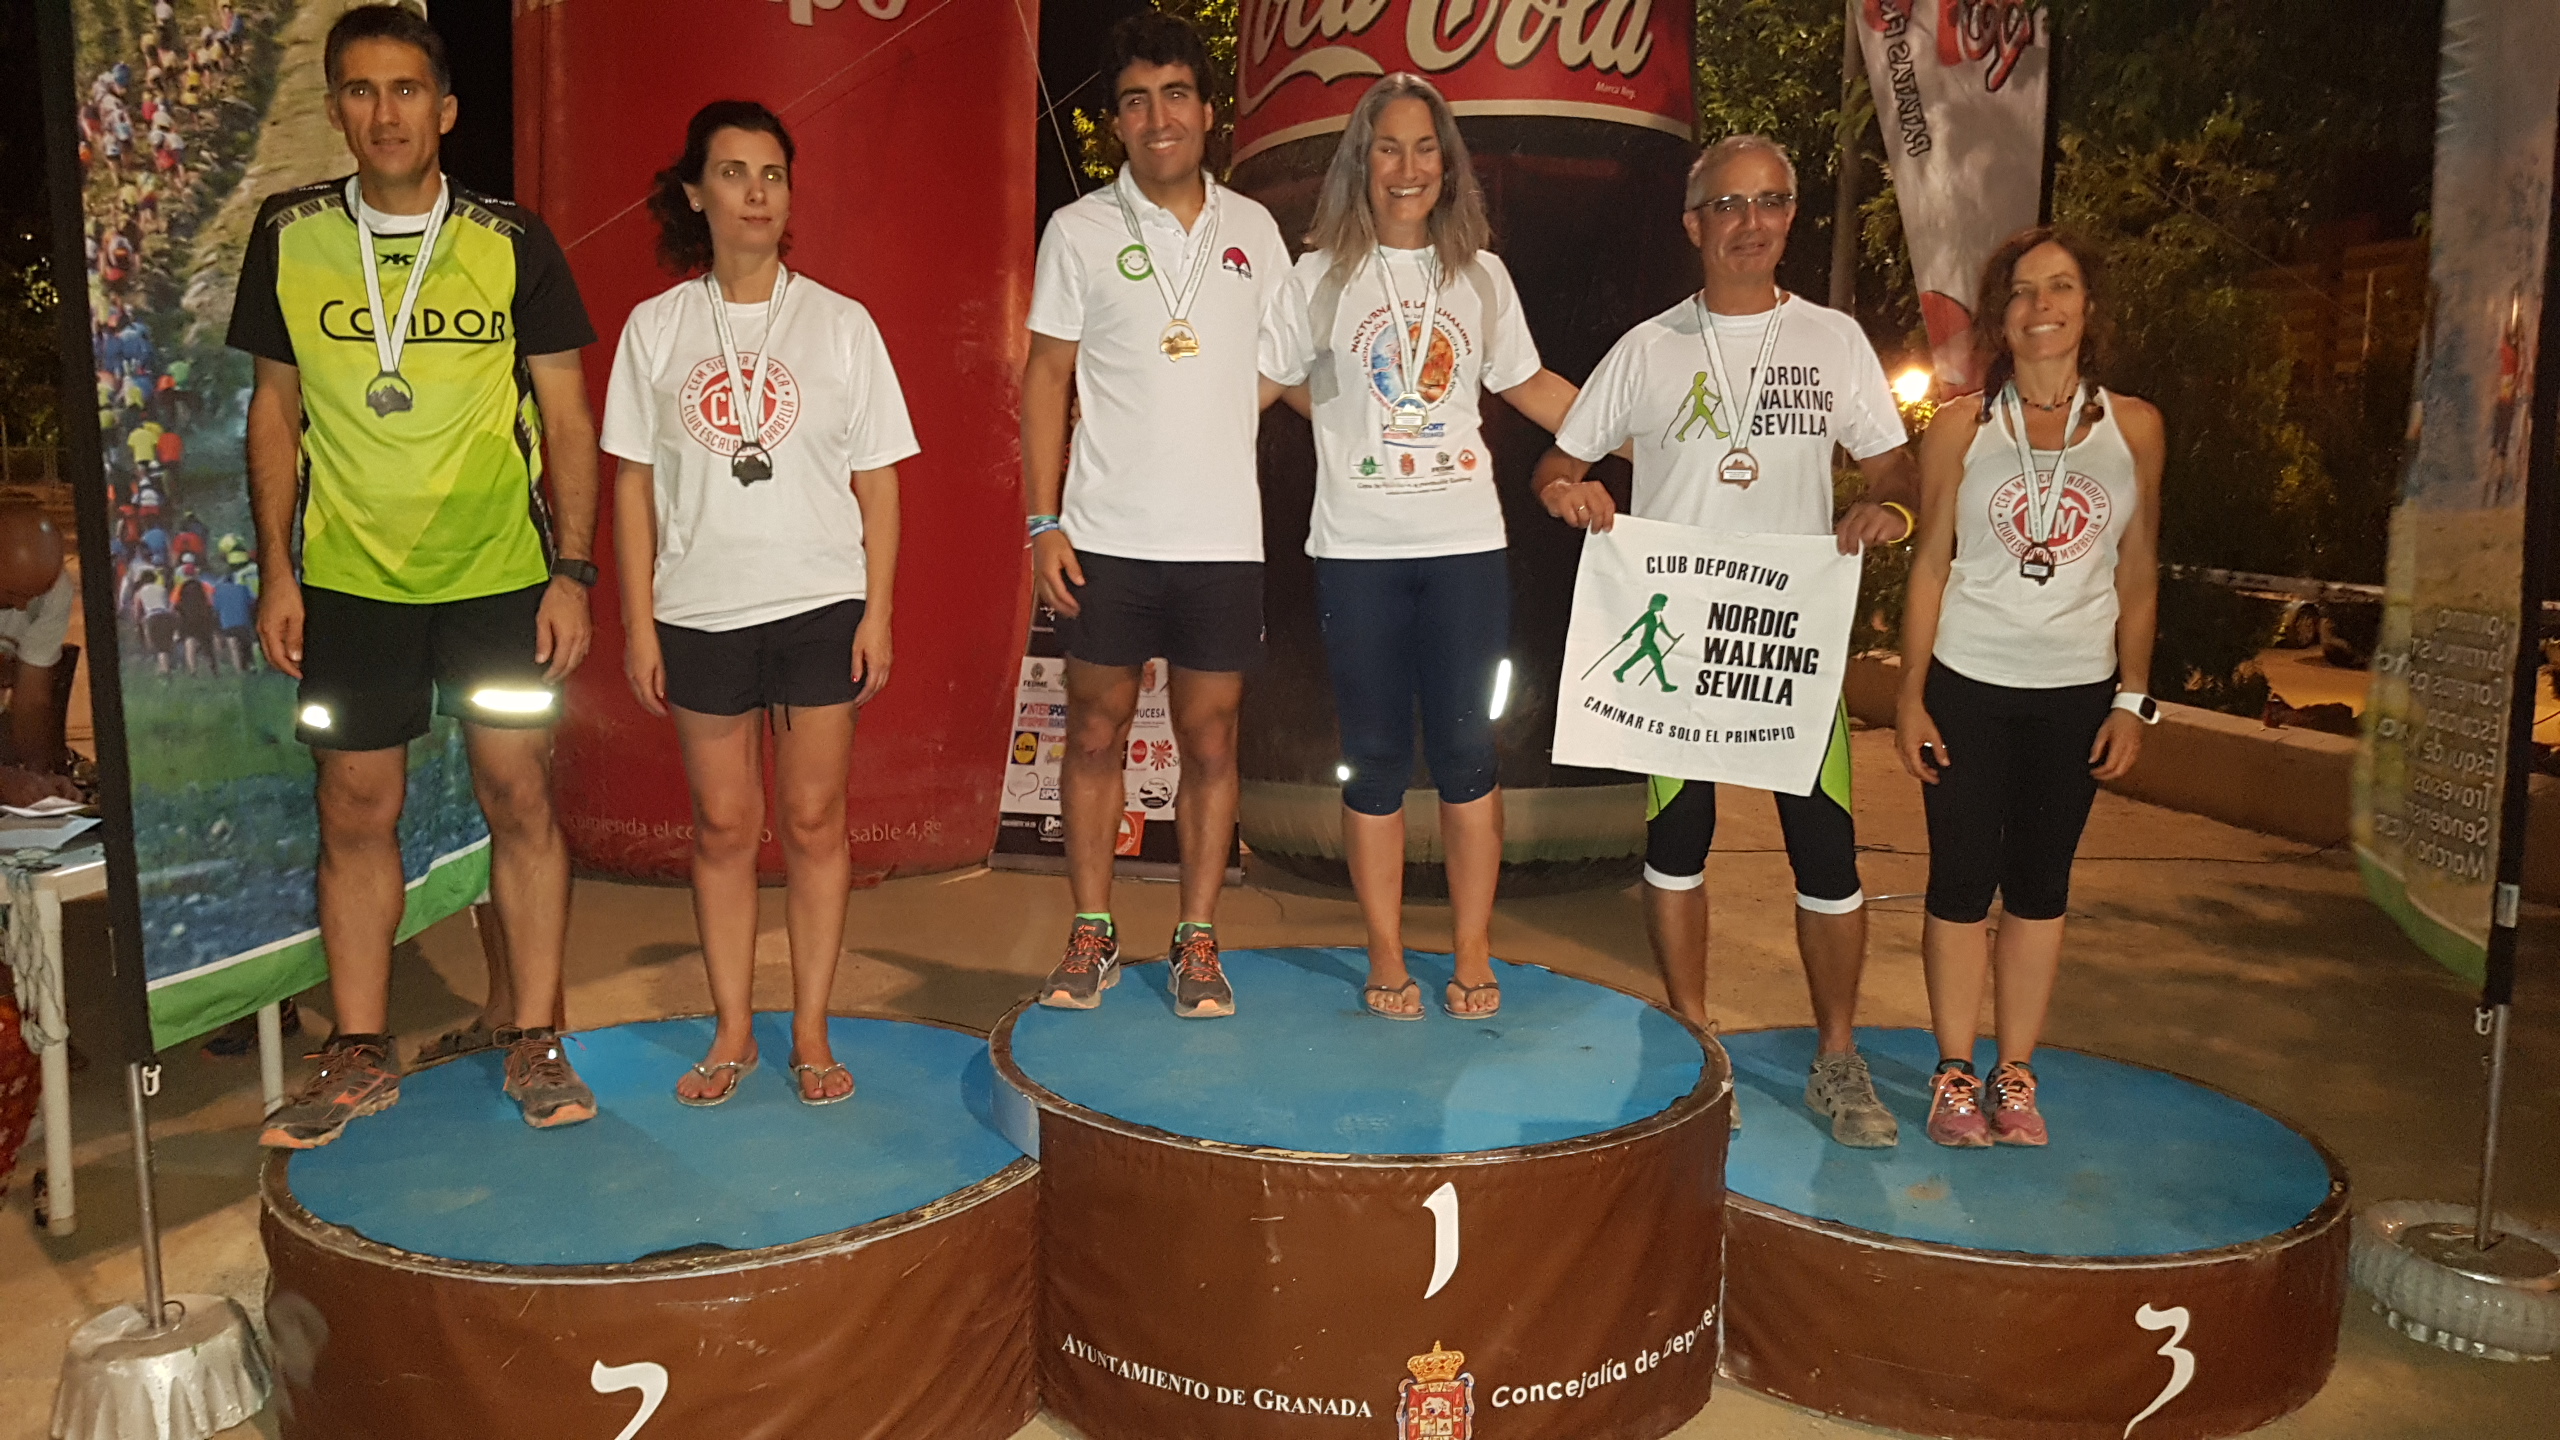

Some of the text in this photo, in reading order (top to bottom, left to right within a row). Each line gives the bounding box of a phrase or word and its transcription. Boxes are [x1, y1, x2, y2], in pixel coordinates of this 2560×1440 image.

[688, 369, 708, 391] CEM
[684, 400, 795, 453] CLUB ESCALA MARBELLA
[1751, 412, 1828, 438] SEVILLA
[1646, 555, 1789, 591] CLUB DEPORTIVO
[1706, 601, 1799, 639] NORDIC
[1702, 636, 1820, 675] WALKING
[1695, 669, 1793, 706] SEVILLA
[1583, 695, 1796, 744] CAMINAR ES SOLO EL PRINCIPIO
[1421, 1181, 1460, 1300] 1
[1061, 1334, 1373, 1418] AYUNTAMIENTO DE GRANADA
[1491, 1358, 1627, 1408] Concejalía
[1634, 1349, 1660, 1374] de
[2123, 1303, 2195, 1440] 3
